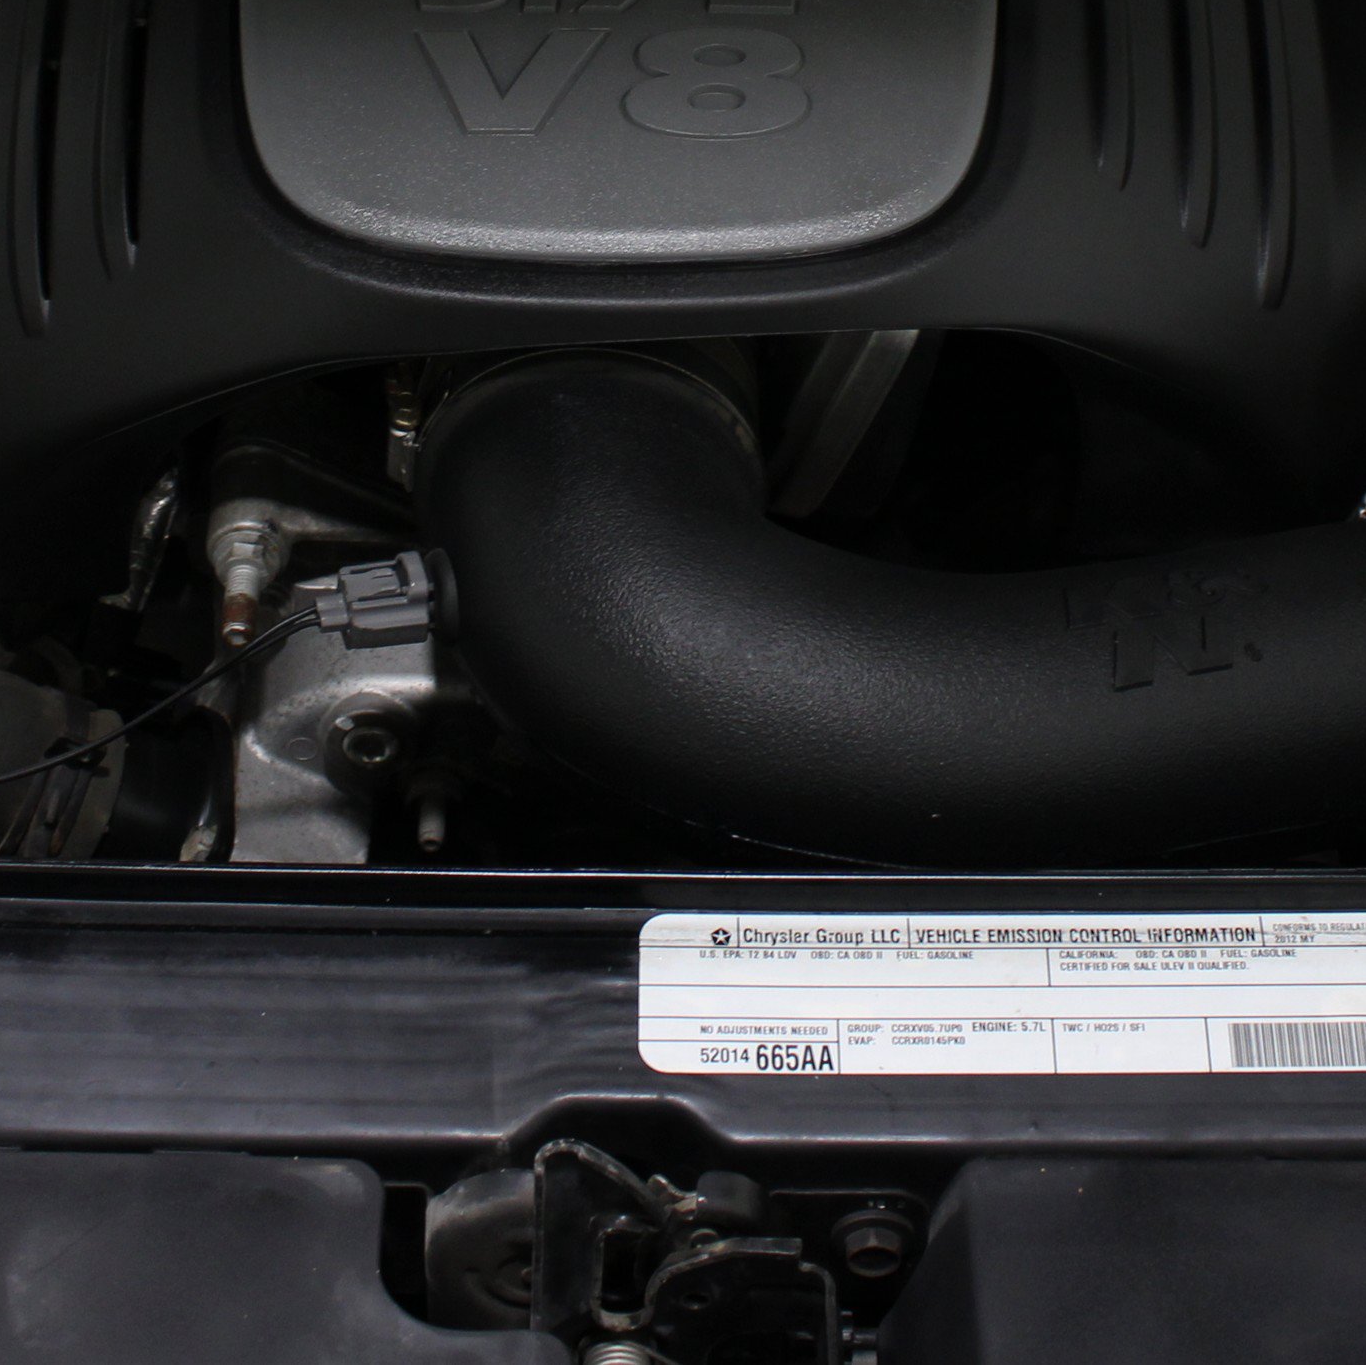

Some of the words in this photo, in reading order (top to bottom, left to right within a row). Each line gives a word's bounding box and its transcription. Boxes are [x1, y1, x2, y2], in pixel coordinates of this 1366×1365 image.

[414, 27, 812, 141] V8
[1272, 923, 1318, 932] CONFORMS
[743, 927, 809, 945] Chrysler
[816, 928, 864, 945] Group
[872, 928, 901, 944] LLC
[915, 928, 980, 944] VEHICLE
[987, 928, 1063, 943] EMISSION
[1069, 928, 1142, 943] CONTROL
[1148, 927, 1256, 943] INFORMATION
[699, 950, 719, 959] U.S.
[723, 950, 744, 959] EPA:
[777, 950, 797, 959] LDV
[810, 950, 833, 960] OBD:
[837, 950, 850, 959] CA
[853, 950, 873, 960] OBD
[896, 950, 924, 960] FUEL:
[927, 950, 974, 960] GASOLINE
[1059, 950, 1118, 959] CALIFORNIA:
[1135, 950, 1159, 959] OBD:
[1161, 950, 1175, 959] CA
[1178, 950, 1197, 959] OBD
[1220, 949, 1247, 958] FUEL:
[1251, 949, 1298, 958] GASOLINE
[1060, 962, 1108, 971] CERTIFIED
[1111, 962, 1130, 971] FOR
[1134, 962, 1158, 971] SALE
[1160, 962, 1184, 971] ULEV
[1197, 961, 1250, 971] QUALIFIED.
[700, 1026, 713, 1035] NO
[717, 1026, 787, 1035] ADJUSTMENTS
[791, 1026, 828, 1036] NEEDED
[847, 1024, 884, 1033] GROUP:
[972, 1021, 1017, 1033] ENGINE:
[1021, 1021, 1047, 1033] 5.7L
[1062, 1024, 1083, 1033] TWC
[1129, 1024, 1145, 1032] SFI
[848, 1036, 876, 1045] EVAP:
[700, 1048, 749, 1064] 52014
[756, 1044, 834, 1071] 665AA
